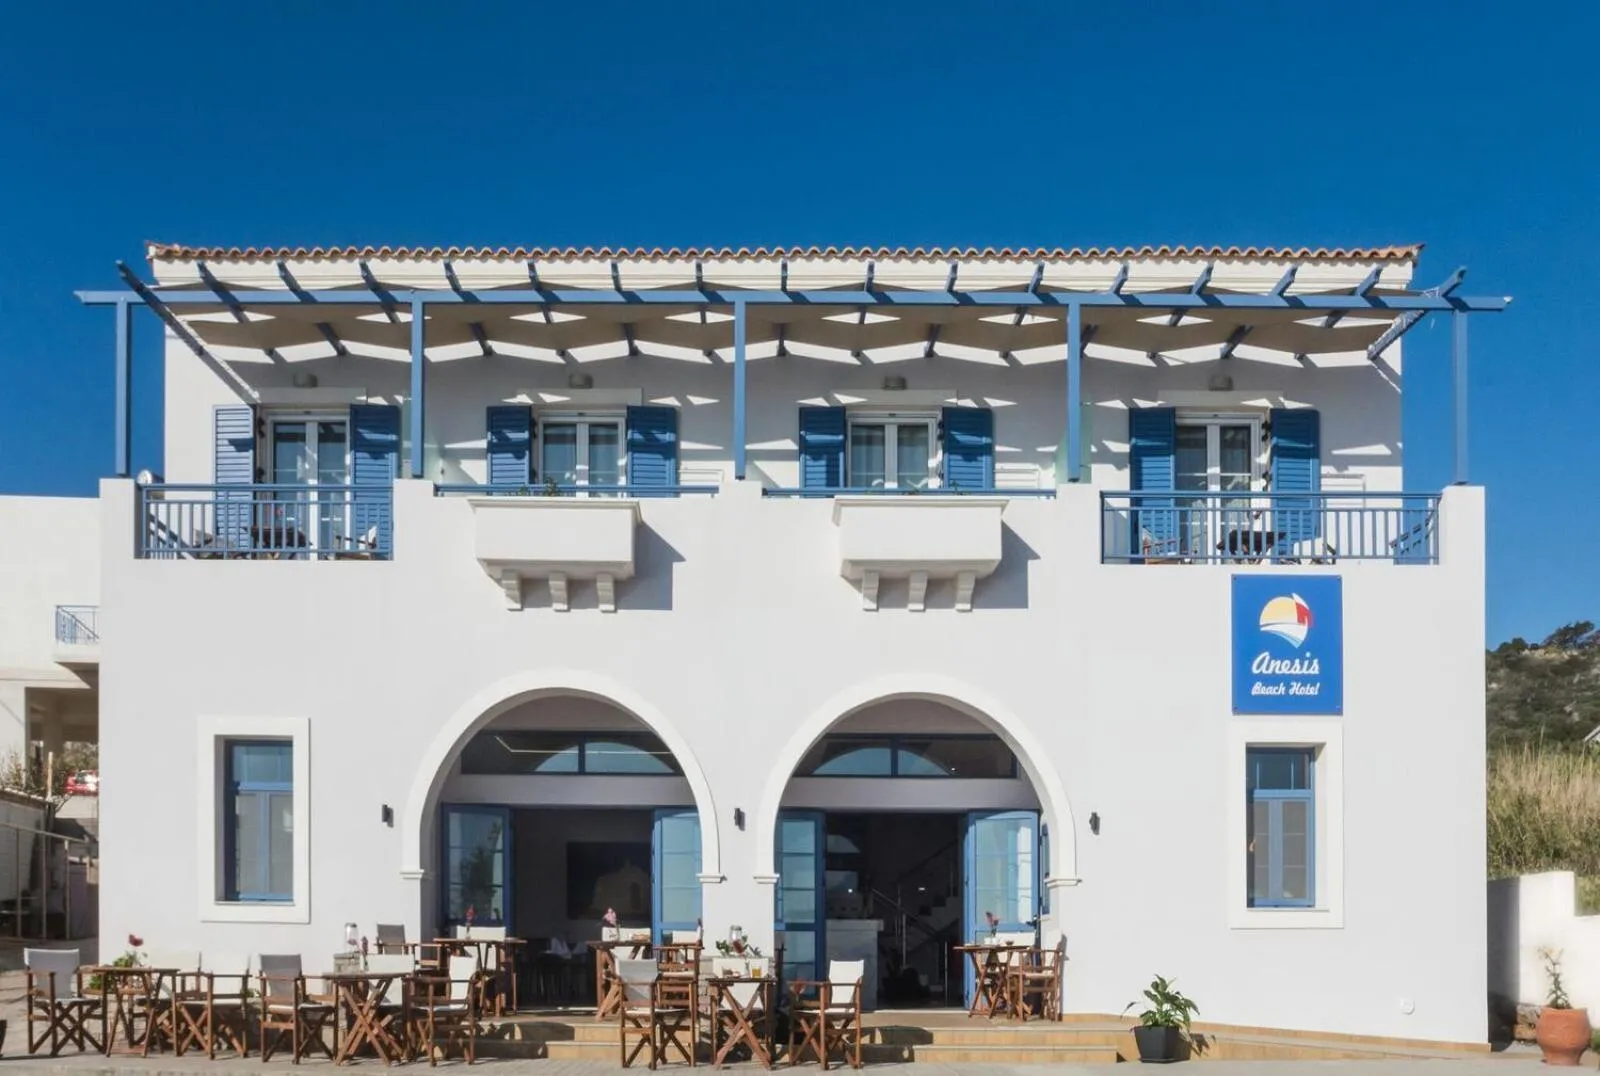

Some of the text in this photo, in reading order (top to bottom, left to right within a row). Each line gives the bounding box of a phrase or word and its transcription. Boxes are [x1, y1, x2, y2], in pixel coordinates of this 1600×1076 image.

[1251, 651, 1320, 675] Anesis
[1251, 682, 1320, 696] Beach Hotel
